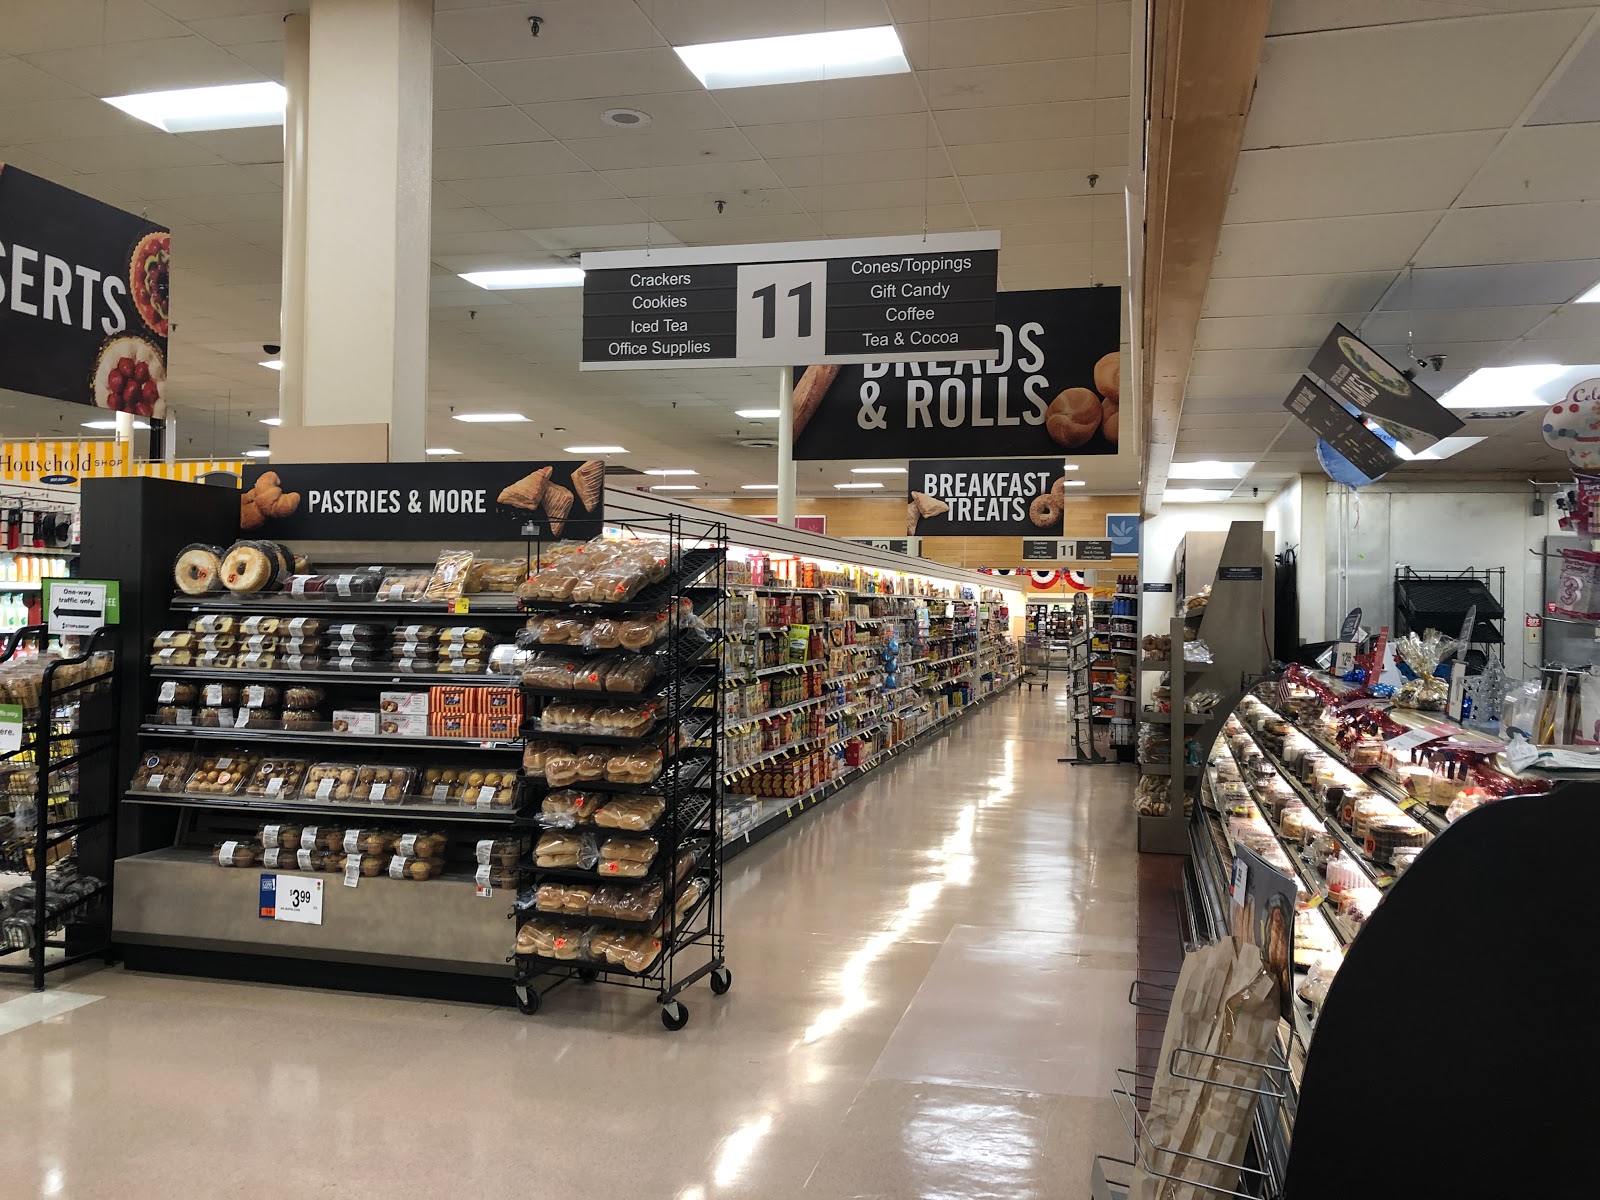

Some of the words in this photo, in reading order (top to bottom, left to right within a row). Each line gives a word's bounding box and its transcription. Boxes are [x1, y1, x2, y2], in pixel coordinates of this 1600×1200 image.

[851, 257, 972, 275] Cones/Toppings
[0, 241, 127, 336] ERTS
[630, 273, 691, 287] Crackers
[870, 284, 897, 299] Gift
[901, 282, 950, 299] Candy
[632, 295, 687, 309] Cookies
[751, 281, 812, 339] 11
[885, 307, 935, 322] Coffee
[631, 319, 659, 333] Iced
[663, 318, 688, 332] Tea
[862, 332, 889, 347] Tea
[893, 331, 905, 346] &
[910, 331, 959, 345] Cocoa
[608, 341, 647, 355] Office
[652, 339, 711, 357] Supplies
[857, 380, 887, 430] &
[906, 374, 1050, 428] ROLLS
[0, 454, 92, 472] Household
[94, 459, 123, 467] SHOP
[924, 472, 1050, 498] BREAKFAST
[308, 489, 400, 514] PASTRIES
[407, 489, 423, 513] &
[429, 489, 487, 514] MORE
[945, 496, 1026, 522] TREATS
[1060, 545, 1074, 556] 11
[63, 588, 91, 597] One-way
[79, 598, 96, 606] only.
